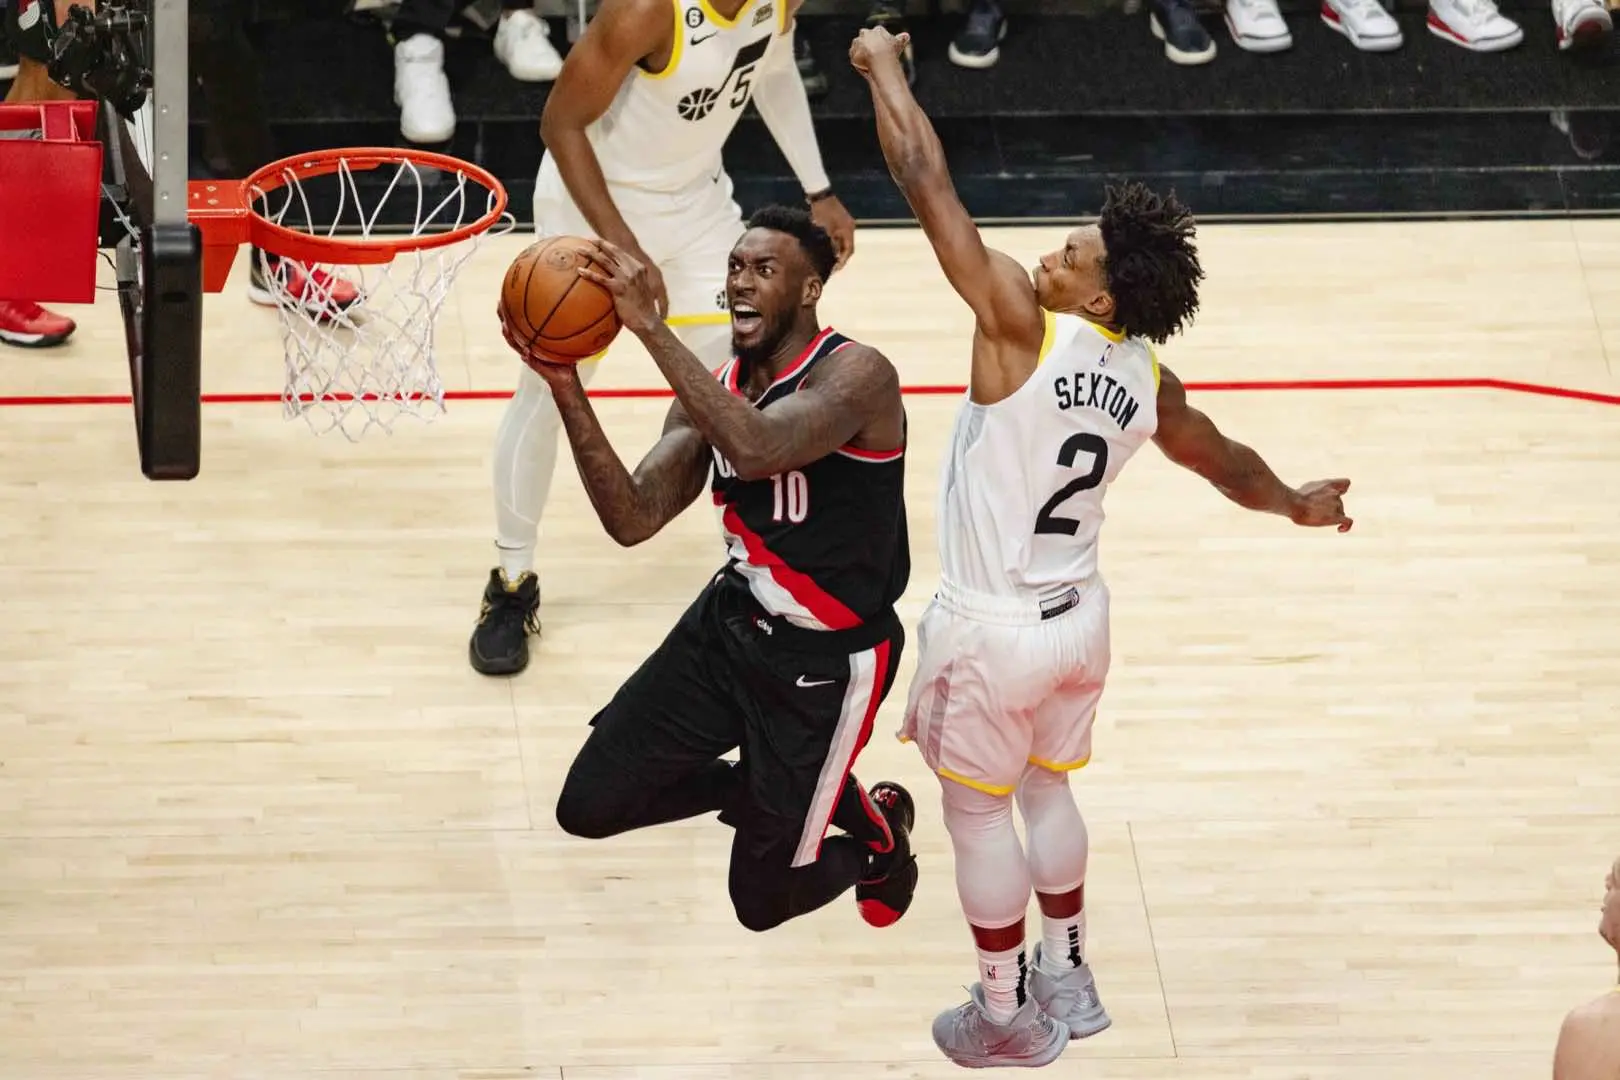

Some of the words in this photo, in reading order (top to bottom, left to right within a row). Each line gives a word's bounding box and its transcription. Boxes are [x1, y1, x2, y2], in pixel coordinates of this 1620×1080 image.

[730, 65, 755, 109] 5
[1054, 372, 1139, 431] SEXTON
[770, 470, 808, 523] 10
[1034, 432, 1108, 536] 2
